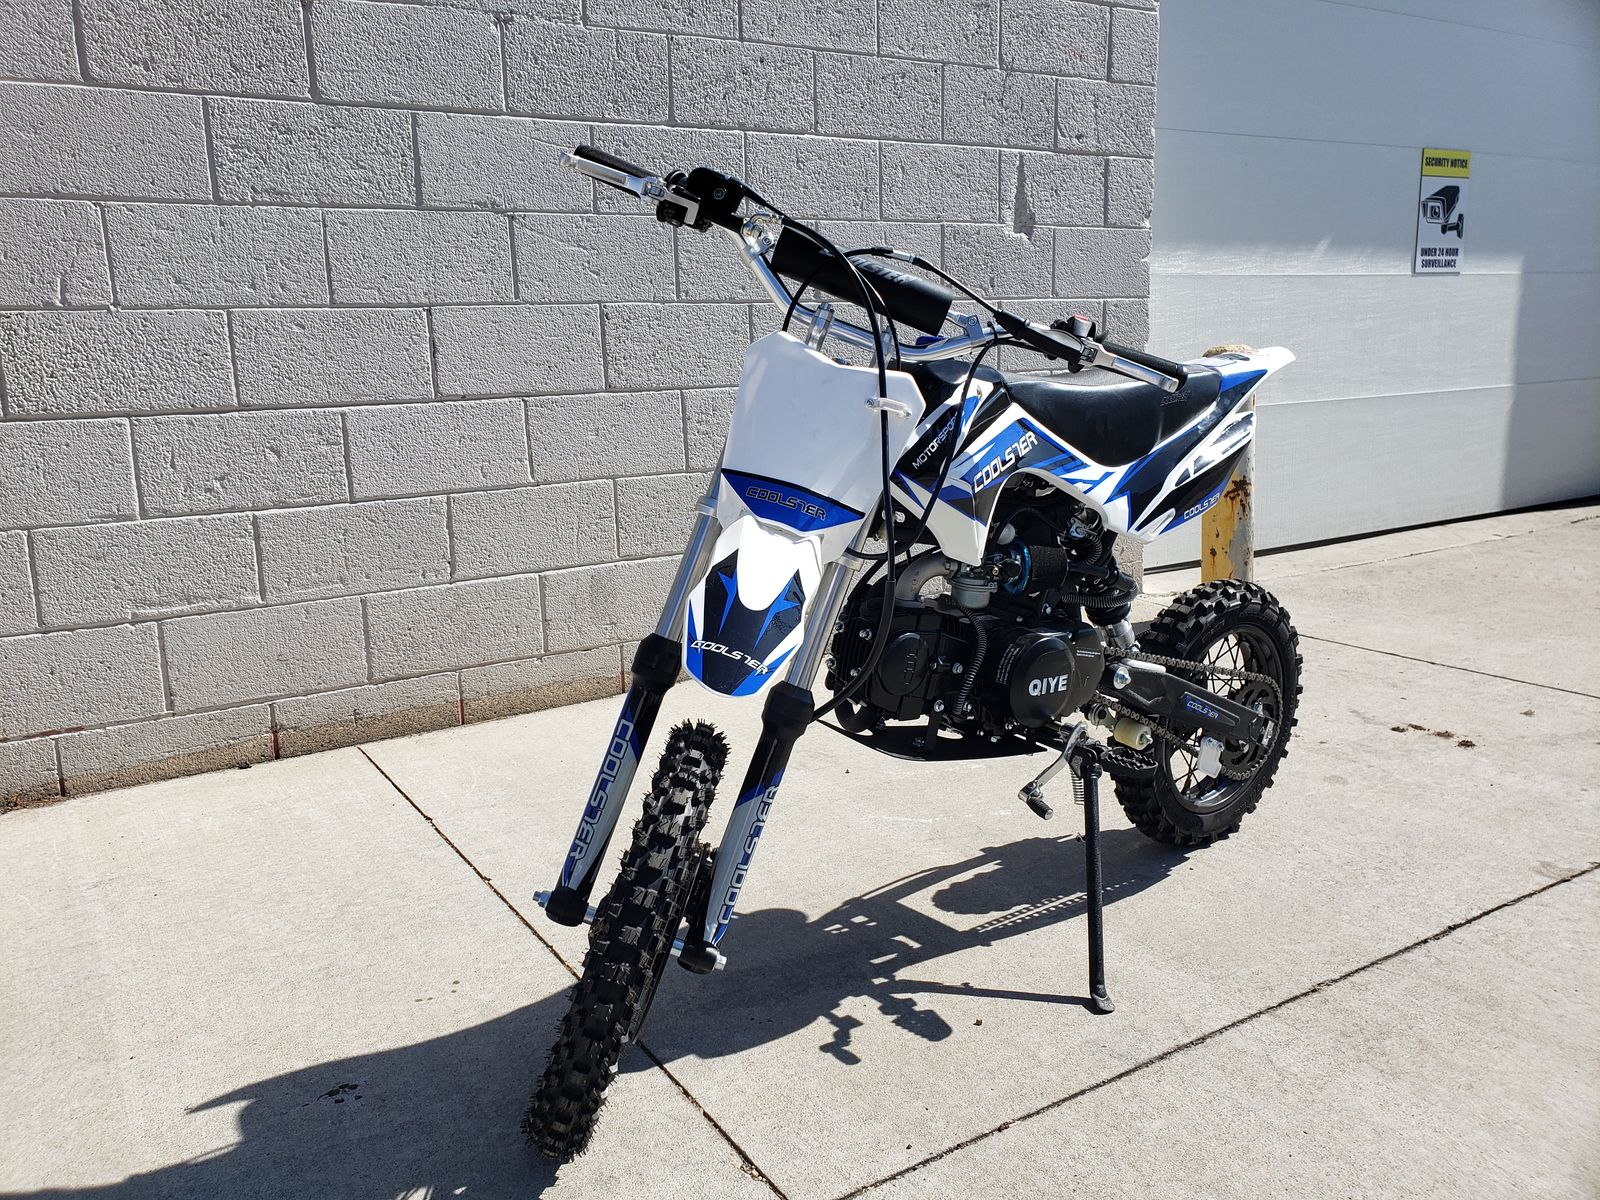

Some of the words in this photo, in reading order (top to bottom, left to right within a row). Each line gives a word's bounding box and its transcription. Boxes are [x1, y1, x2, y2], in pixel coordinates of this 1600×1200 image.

[1424, 156, 1449, 168] SECURITY
[1450, 158, 1468, 169] NOTICE
[1420, 247, 1438, 257] UNDER
[1438, 248, 1444, 257] 24
[1445, 248, 1459, 257] HOUR
[1421, 259, 1457, 269] SURVEILLANCE
[973, 431, 1039, 493] COOLSTER
[745, 486, 827, 521] COOLSTER
[1183, 492, 1220, 520] COOLSTER
[690, 640, 769, 676] COOLSTER
[1028, 674, 1069, 697] QIYE
[1186, 700, 1219, 719] COOLSTER
[569, 718, 634, 861] COOLSTER
